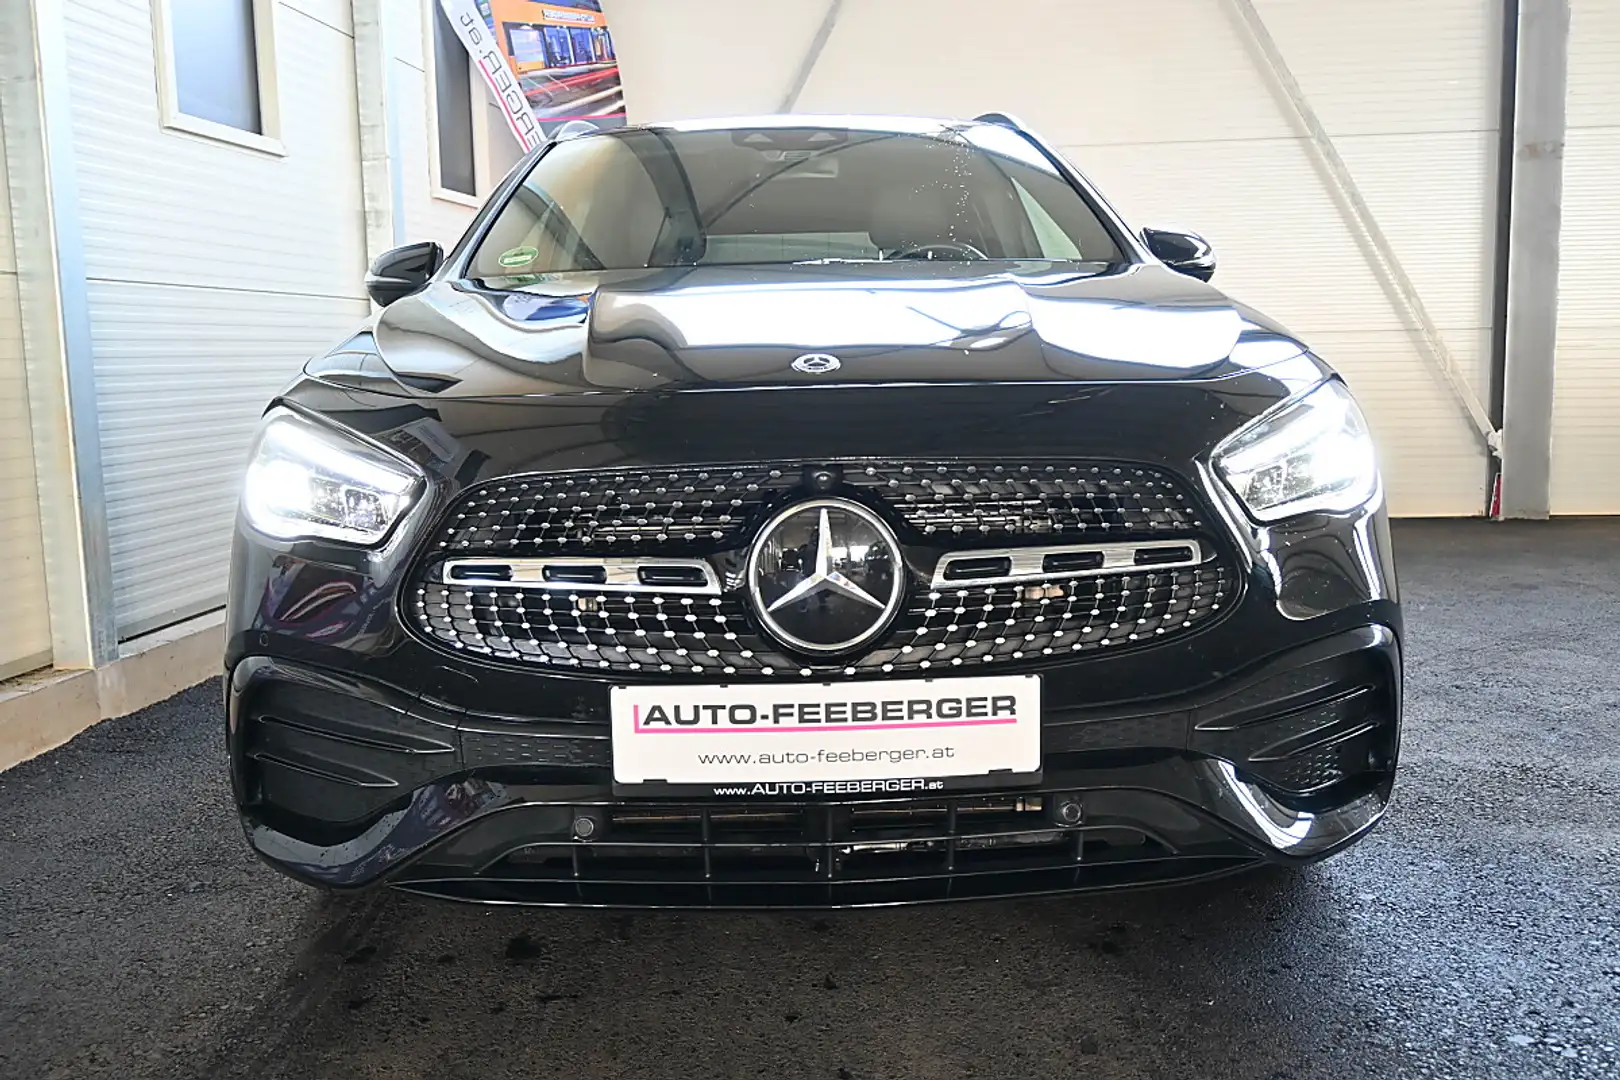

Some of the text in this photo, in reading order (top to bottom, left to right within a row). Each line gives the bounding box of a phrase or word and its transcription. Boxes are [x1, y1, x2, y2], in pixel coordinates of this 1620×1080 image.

[642, 695, 1017, 726] AUTO-FEEBERGER
[697, 745, 955, 765] www.auto-feeberger.at
[713, 778, 944, 796] www.AUTO-FEEBERGER.at
